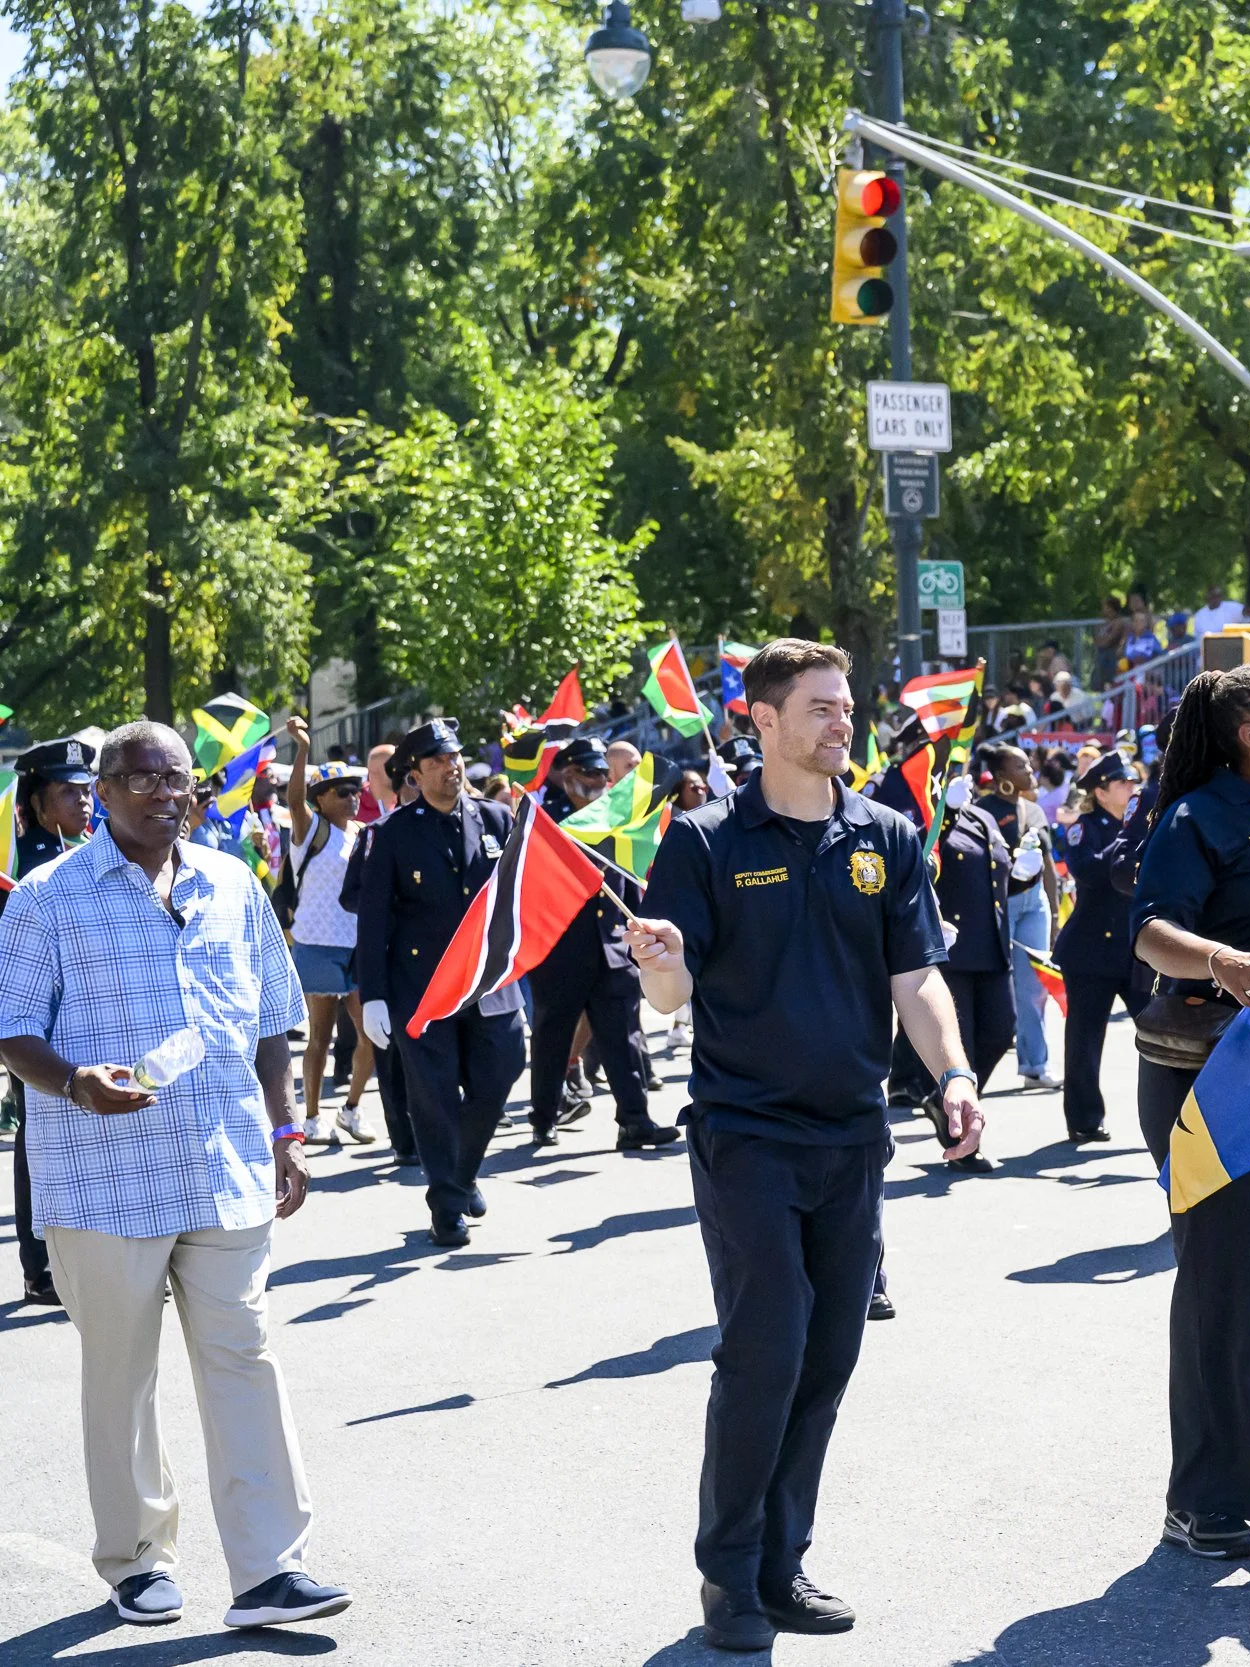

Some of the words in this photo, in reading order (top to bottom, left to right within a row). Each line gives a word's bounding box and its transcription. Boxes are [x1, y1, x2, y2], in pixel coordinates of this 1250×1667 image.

[875, 392, 944, 413] PASSENGER
[876, 418, 908, 437] CARS
[914, 419, 944, 438] ONLY
[734, 871, 753, 880] DEPUTY
[735, 879, 744, 888] P.
[745, 873, 789, 886] GALLAHUE
